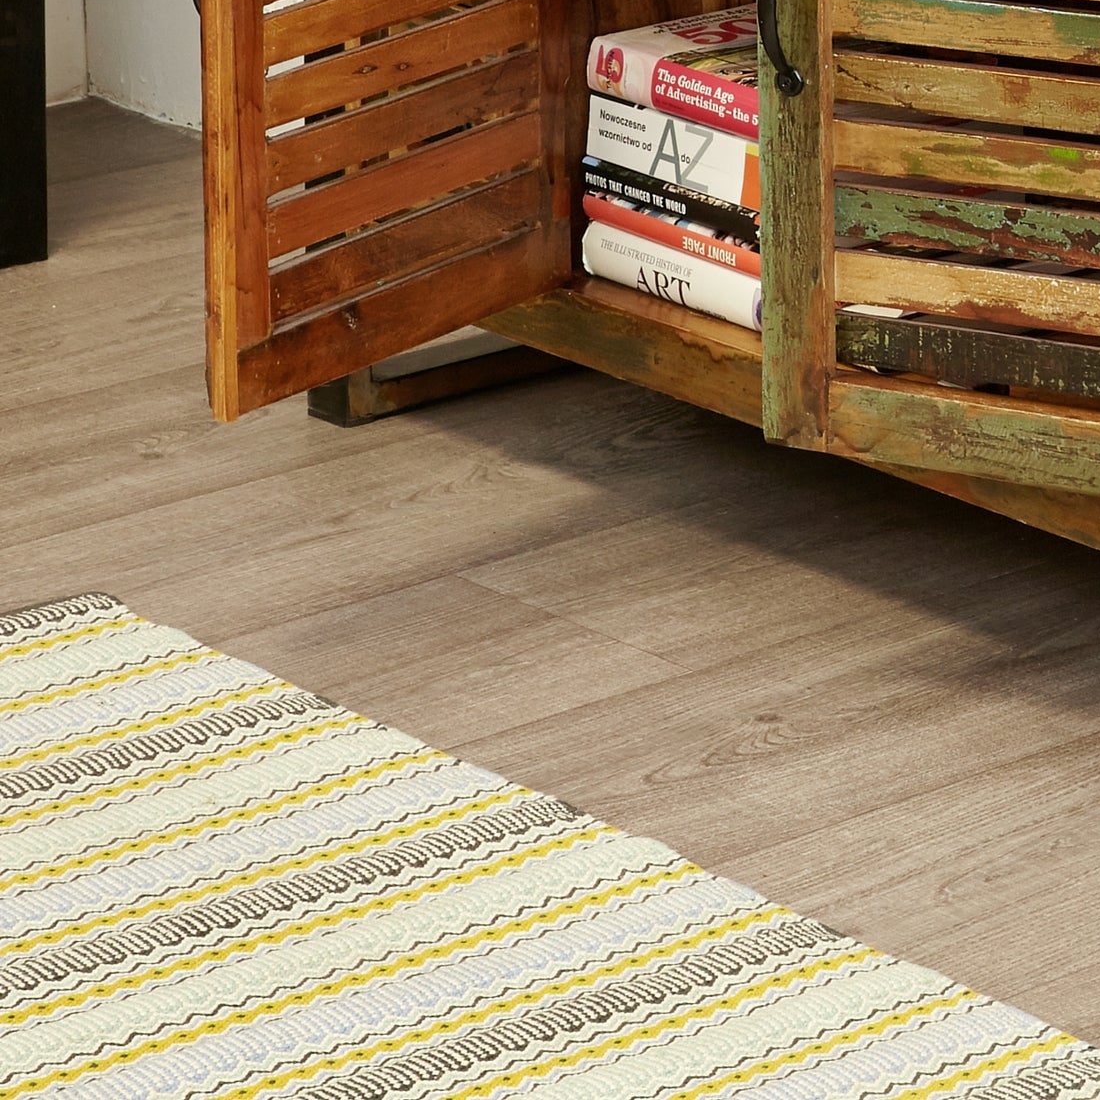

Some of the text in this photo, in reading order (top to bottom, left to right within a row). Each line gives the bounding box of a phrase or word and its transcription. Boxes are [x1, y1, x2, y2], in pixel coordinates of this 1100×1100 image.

[655, 84, 666, 95] of
[657, 68, 734, 104] The Golden Age
[599, 109, 647, 132] Nowoczesne
[598, 118, 714, 193] wzornictwo od A do Z
[585, 172, 607, 189] PHOTOS
[608, 179, 623, 194] THAT
[624, 185, 651, 203] CHANGED
[651, 194, 664, 208] THE
[665, 198, 687, 215] WORLD
[600, 238, 694, 278] THE ILLUSTRATED HISTORY OF
[682, 236, 736, 266] FRONT PAGE
[636, 265, 691, 307] ART
